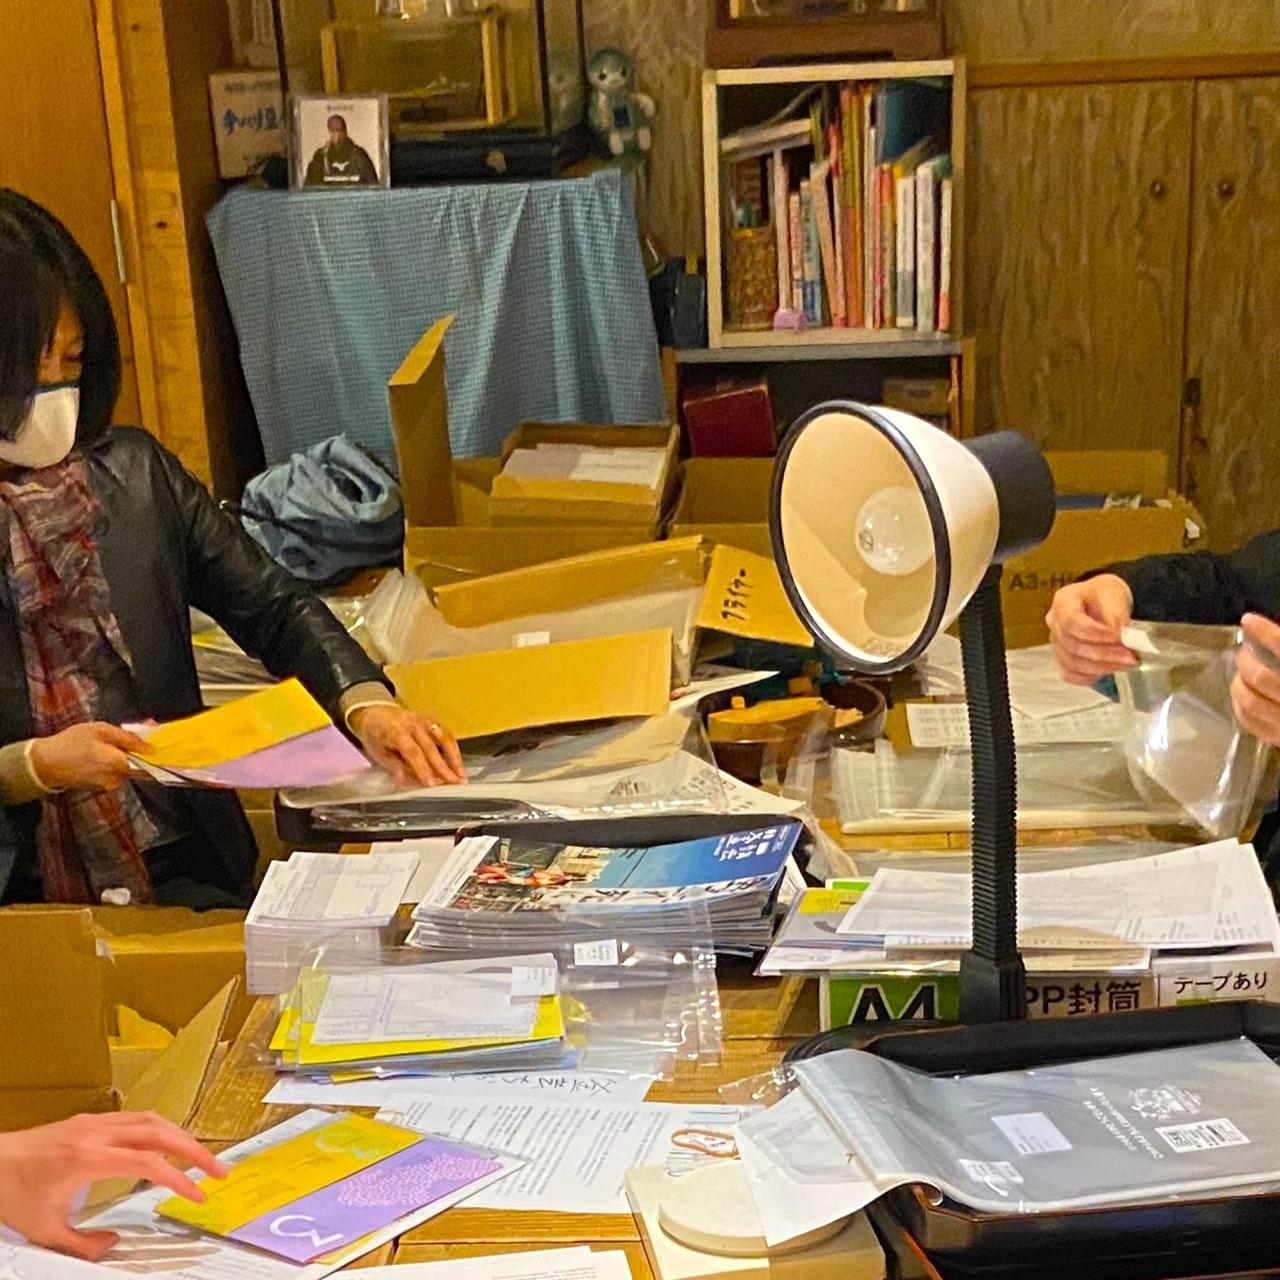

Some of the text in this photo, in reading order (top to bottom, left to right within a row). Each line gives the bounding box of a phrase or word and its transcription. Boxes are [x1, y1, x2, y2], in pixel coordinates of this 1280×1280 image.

[1173, 971, 1269, 995] テープあり
